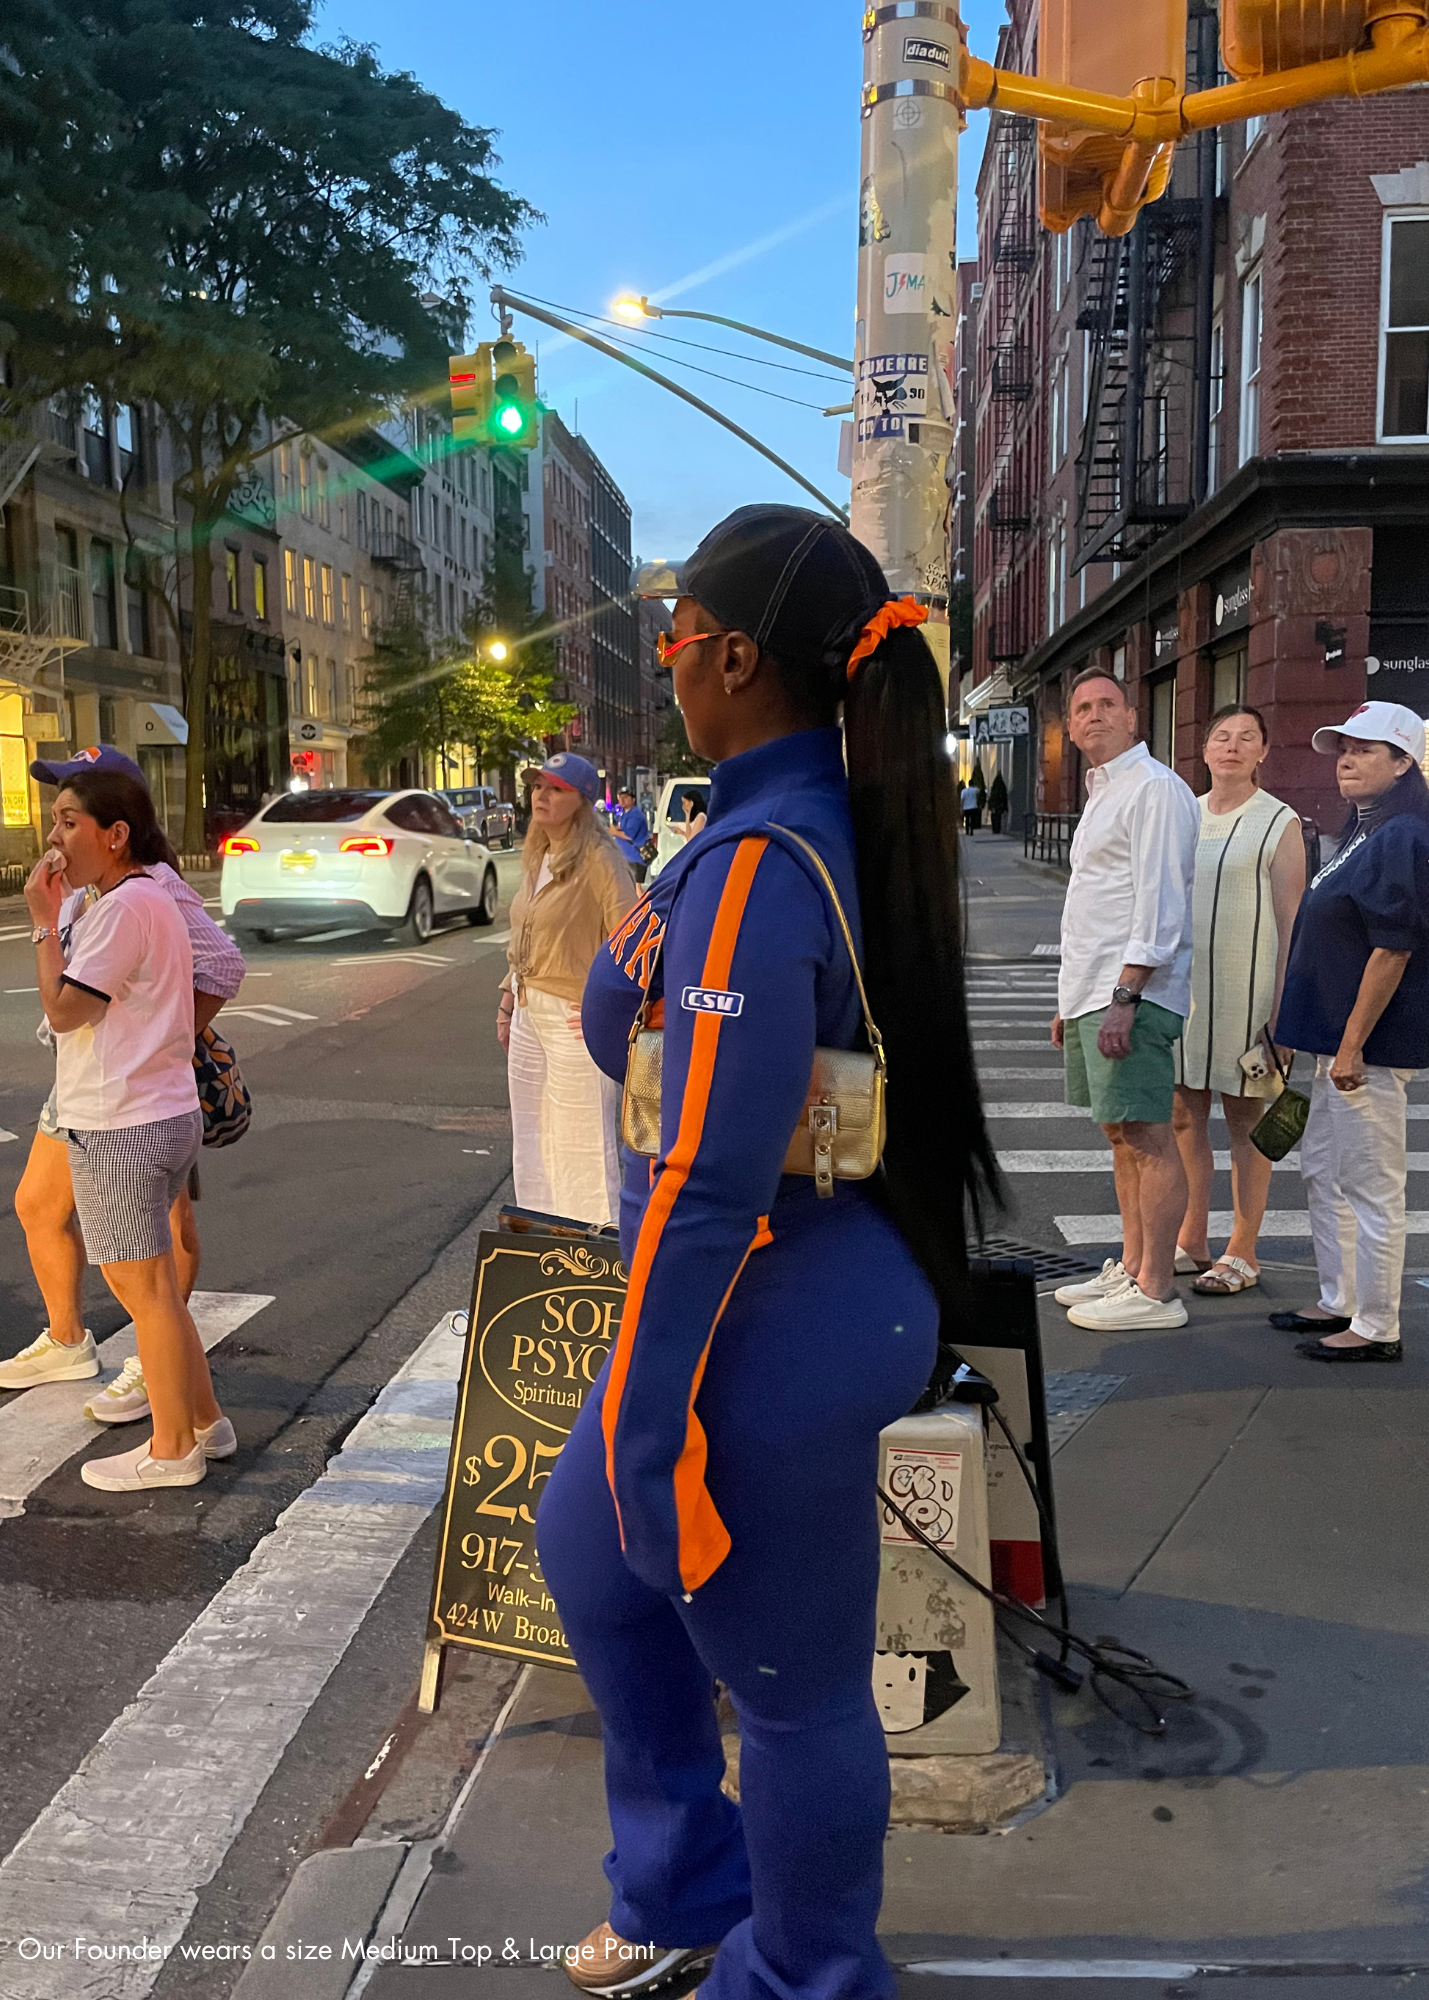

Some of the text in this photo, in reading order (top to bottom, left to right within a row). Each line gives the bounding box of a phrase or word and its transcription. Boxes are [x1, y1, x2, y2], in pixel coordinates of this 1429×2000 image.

[907, 43, 949, 64] diaduit
[909, 388, 925, 399] 90
[881, 417, 905, 432] TO
[608, 891, 666, 990] RK
[688, 992, 734, 1012] CSV
[513, 1379, 583, 1409] Spiritual
[462, 1434, 566, 1527] $25
